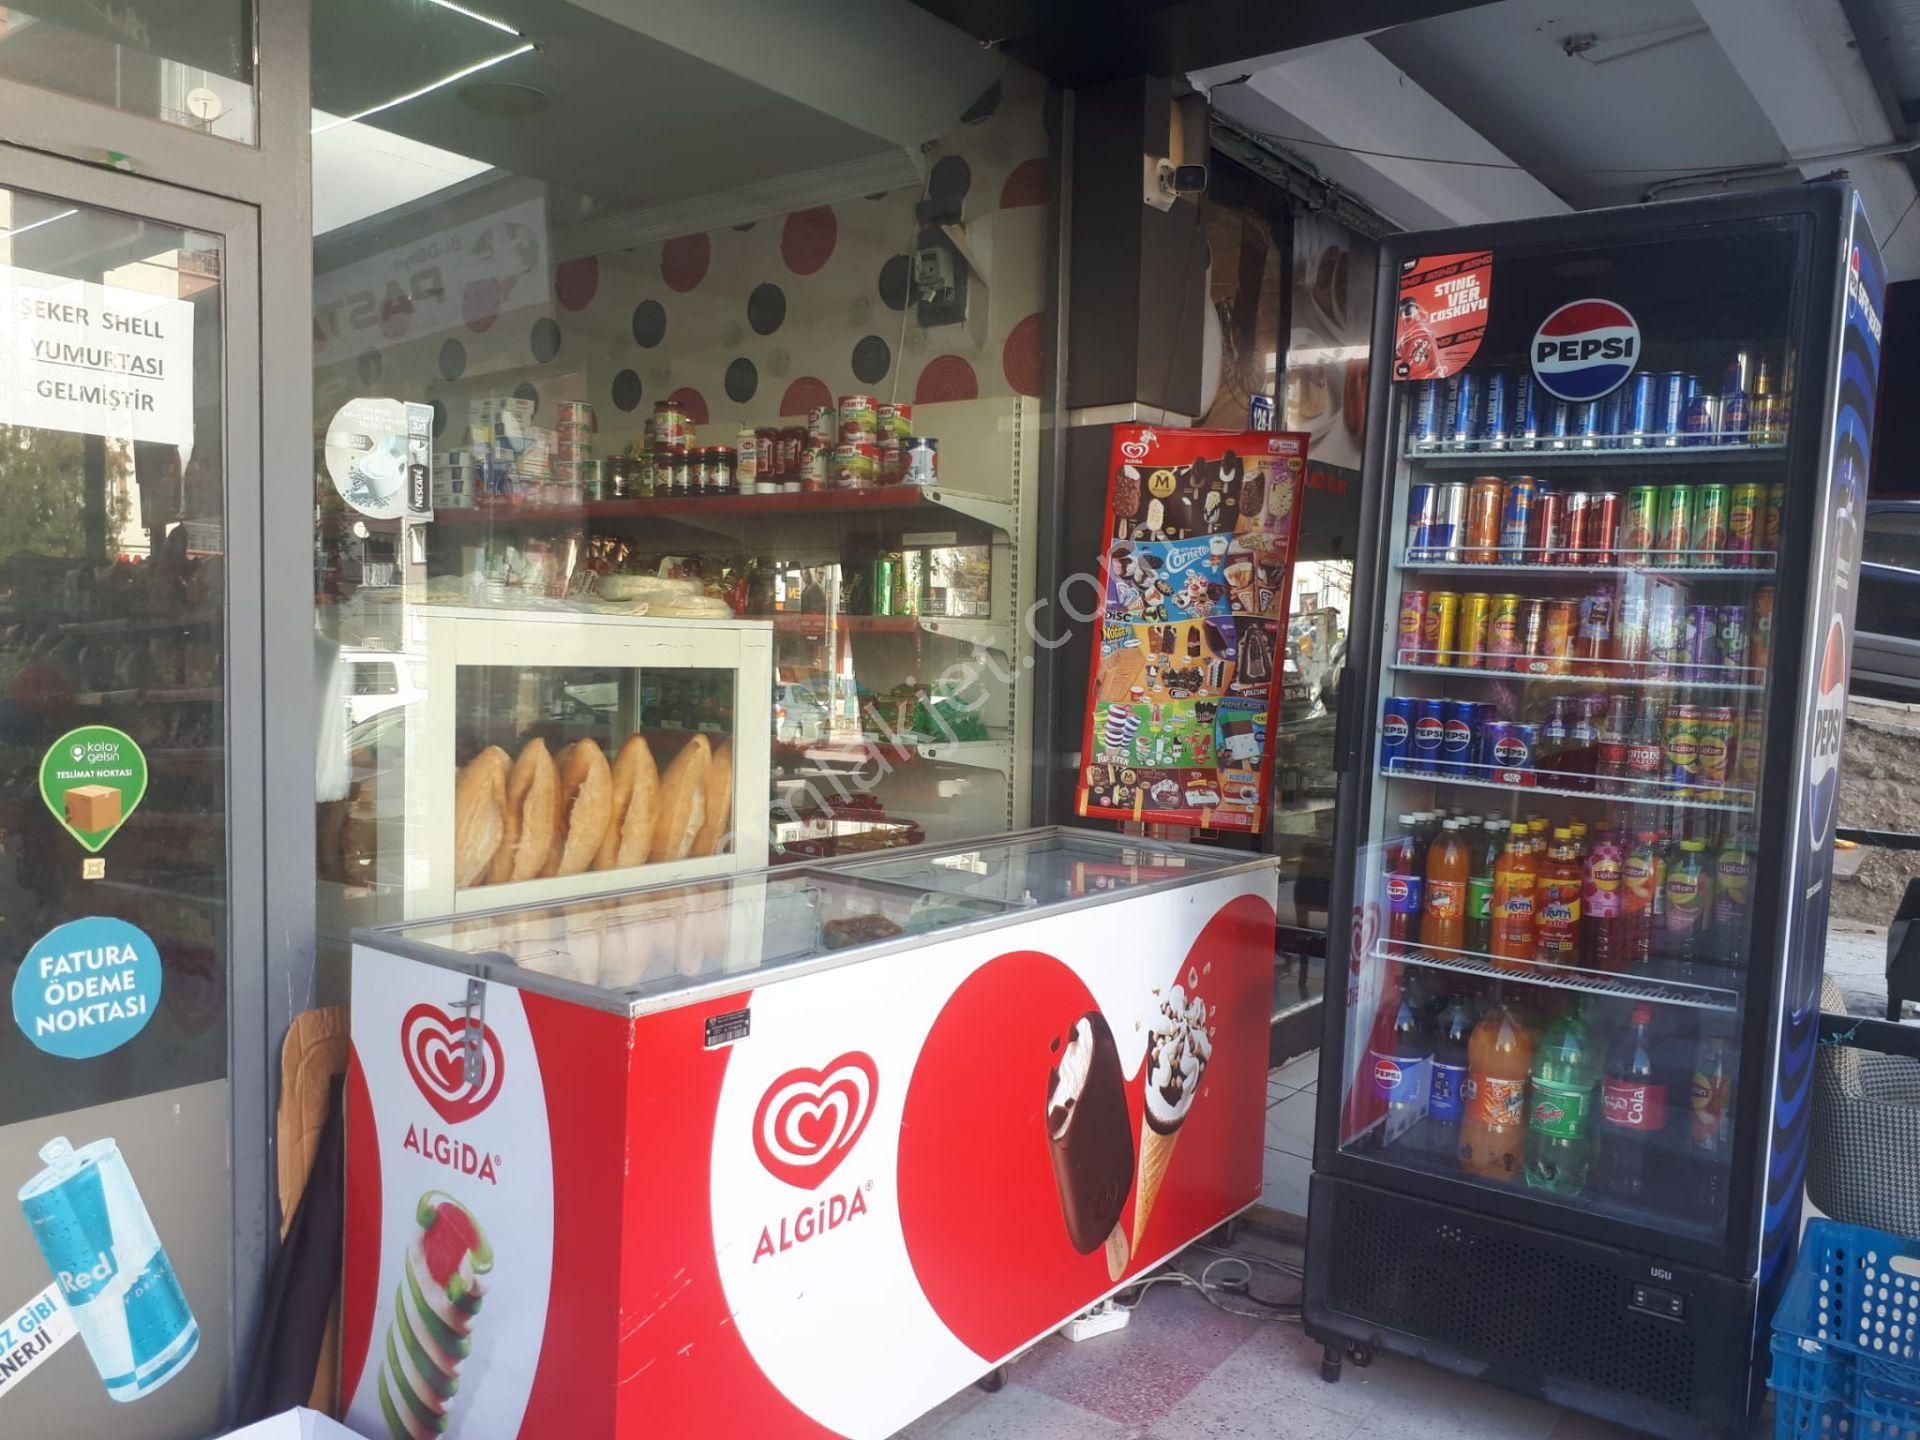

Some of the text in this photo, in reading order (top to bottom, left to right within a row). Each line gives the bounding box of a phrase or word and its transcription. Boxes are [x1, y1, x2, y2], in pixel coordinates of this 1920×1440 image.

[1447, 286, 1481, 308] VER
[101, 311, 164, 339] SHELL
[30, 338, 164, 376] YUMURTASI
[1536, 337, 1635, 363] PEPSI
[37, 379, 155, 412] GELMİŞTİR
[1487, 400, 1498, 424] DARK
[1166, 545, 1210, 574] Cornetto
[1384, 725, 1407, 735] EPSI
[1445, 731, 1469, 740] EPSI
[1813, 708, 1841, 760] PEPSI
[87, 751, 120, 765] gelsin
[1496, 747, 1526, 756] PEPSI
[56, 768, 133, 780] TESLİMAT NOKTASI
[39, 943, 139, 979] FATURA
[44, 969, 137, 1006] ÖDEME
[35, 994, 147, 1037] NOKTASI
[1375, 1069, 1400, 1080] PEPSI
[1627, 1086, 1645, 1124] Cola
[58, 1250, 113, 1294] Red
[1650, 1267, 1672, 1280] UGU
[18, 1293, 58, 1334] GİBİ
